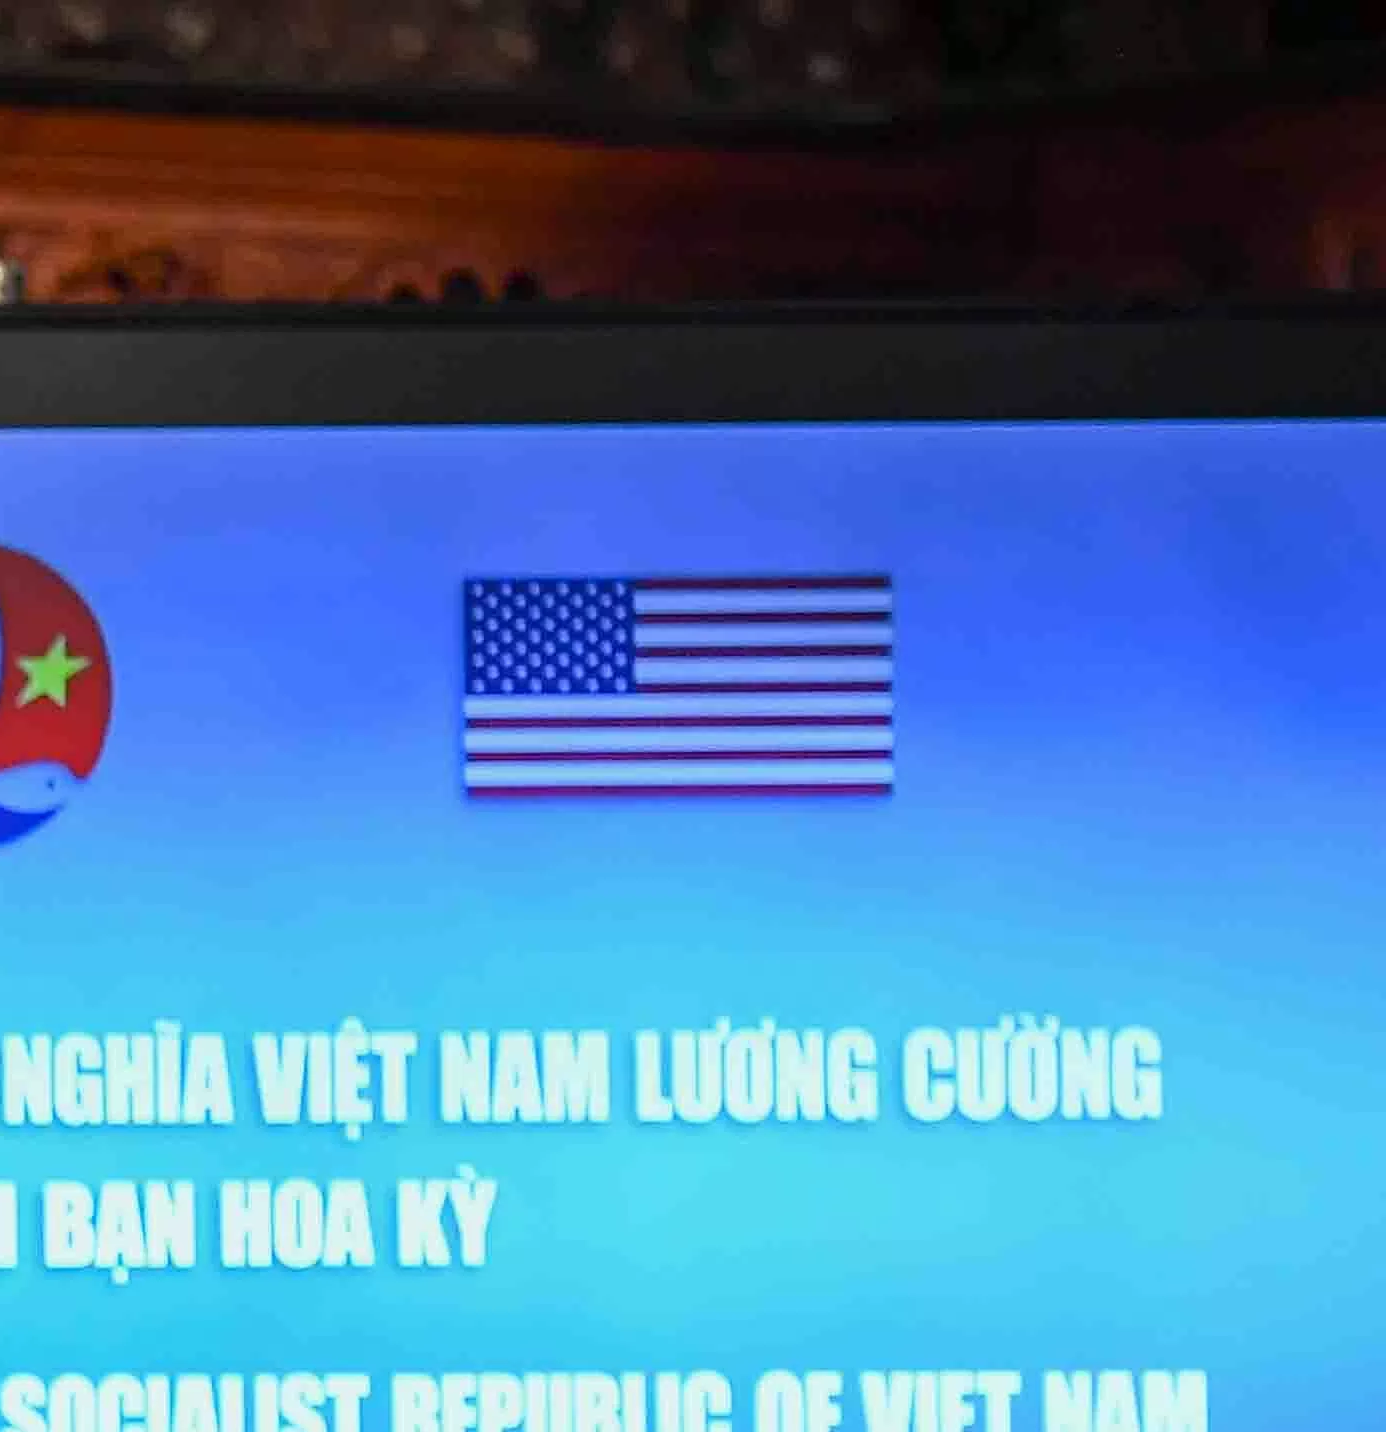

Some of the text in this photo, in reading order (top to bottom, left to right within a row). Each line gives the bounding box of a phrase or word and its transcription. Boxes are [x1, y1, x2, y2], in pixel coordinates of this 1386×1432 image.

[3, 1019, 233, 1126] NGHĨA
[254, 1016, 418, 1140] VIỆT
[441, 1030, 610, 1123] NAM
[635, 1016, 878, 1122] LƯƠNG
[904, 1013, 1163, 1122] CƯỜNG
[44, 1181, 196, 1284] BẠN
[222, 1178, 376, 1268] HOA
[398, 1165, 497, 1267] KỲ
